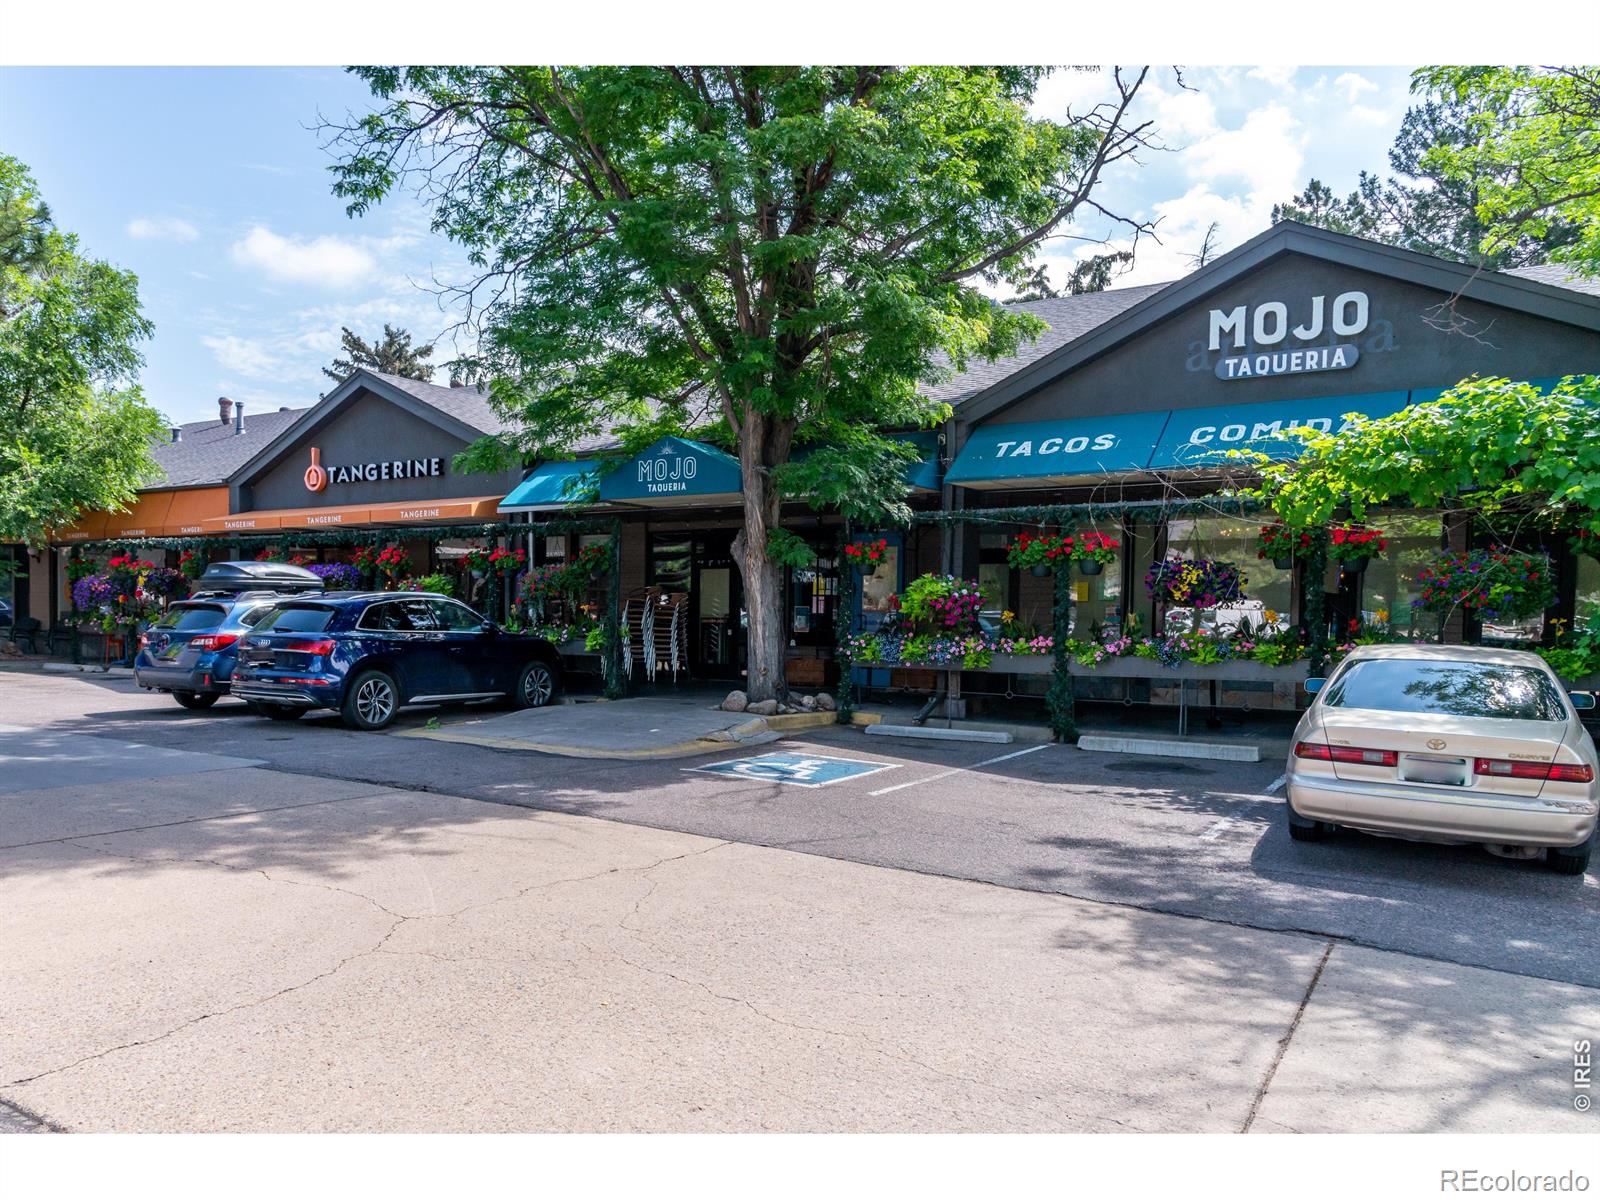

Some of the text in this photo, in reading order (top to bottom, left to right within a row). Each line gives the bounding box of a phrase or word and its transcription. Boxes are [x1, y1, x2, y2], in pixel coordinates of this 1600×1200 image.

[1208, 291, 1369, 351] MOJO
[1225, 347, 1347, 377] TAQUERIA
[995, 433, 1116, 458] TACOS
[327, 457, 440, 484] TANGERINE
[638, 456, 697, 482] MOJO
[648, 482, 687, 493] TAQUERIA
[224, 520, 256, 530] TANGERINE
[306, 514, 342, 525] TANGERINE
[400, 508, 440, 519] TANGERINE
